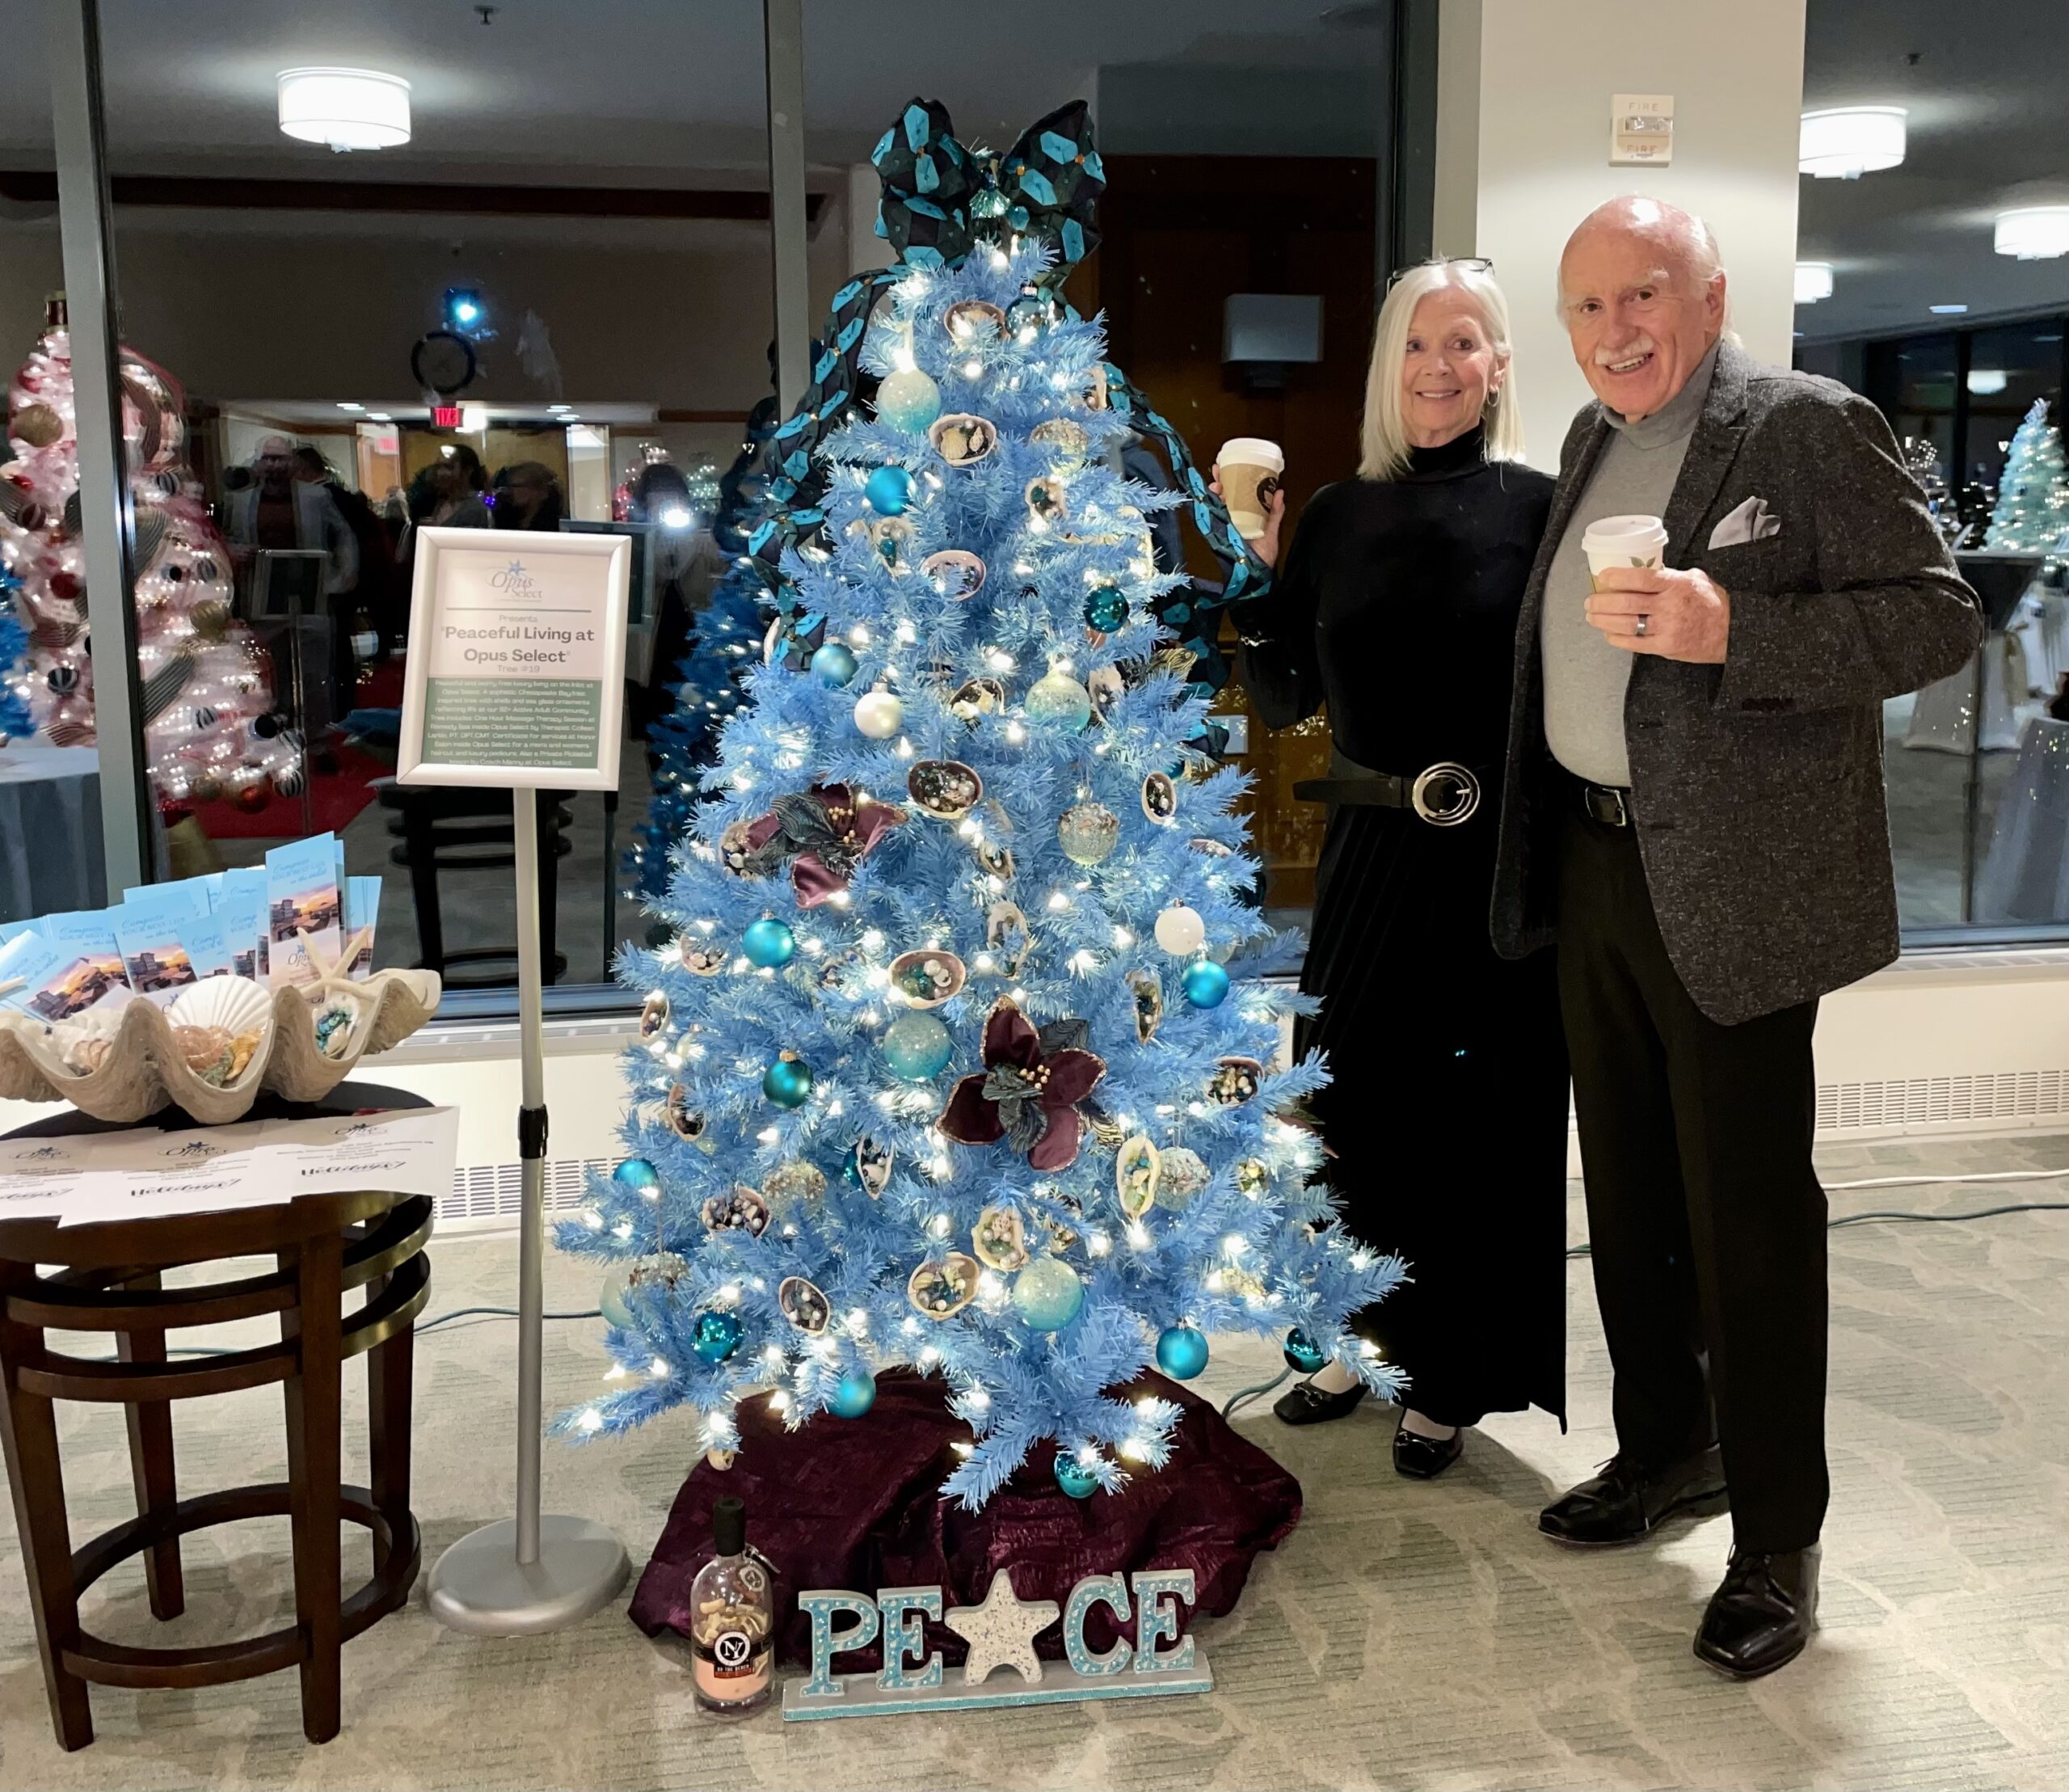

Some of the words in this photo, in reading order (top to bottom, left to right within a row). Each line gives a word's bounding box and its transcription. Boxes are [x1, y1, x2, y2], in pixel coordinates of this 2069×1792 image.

[1629, 102, 1658, 112] FIRE
[1626, 145, 1658, 154] FIRE
[491, 571, 534, 593] Opus
[511, 588, 542, 599] Select
[499, 614, 538, 623] Presents
[524, 626, 571, 643] Living
[575, 629, 595, 641] at
[463, 648, 508, 664] Opus
[521, 665, 540, 673] #19
[723, 1641, 744, 1659] NY
